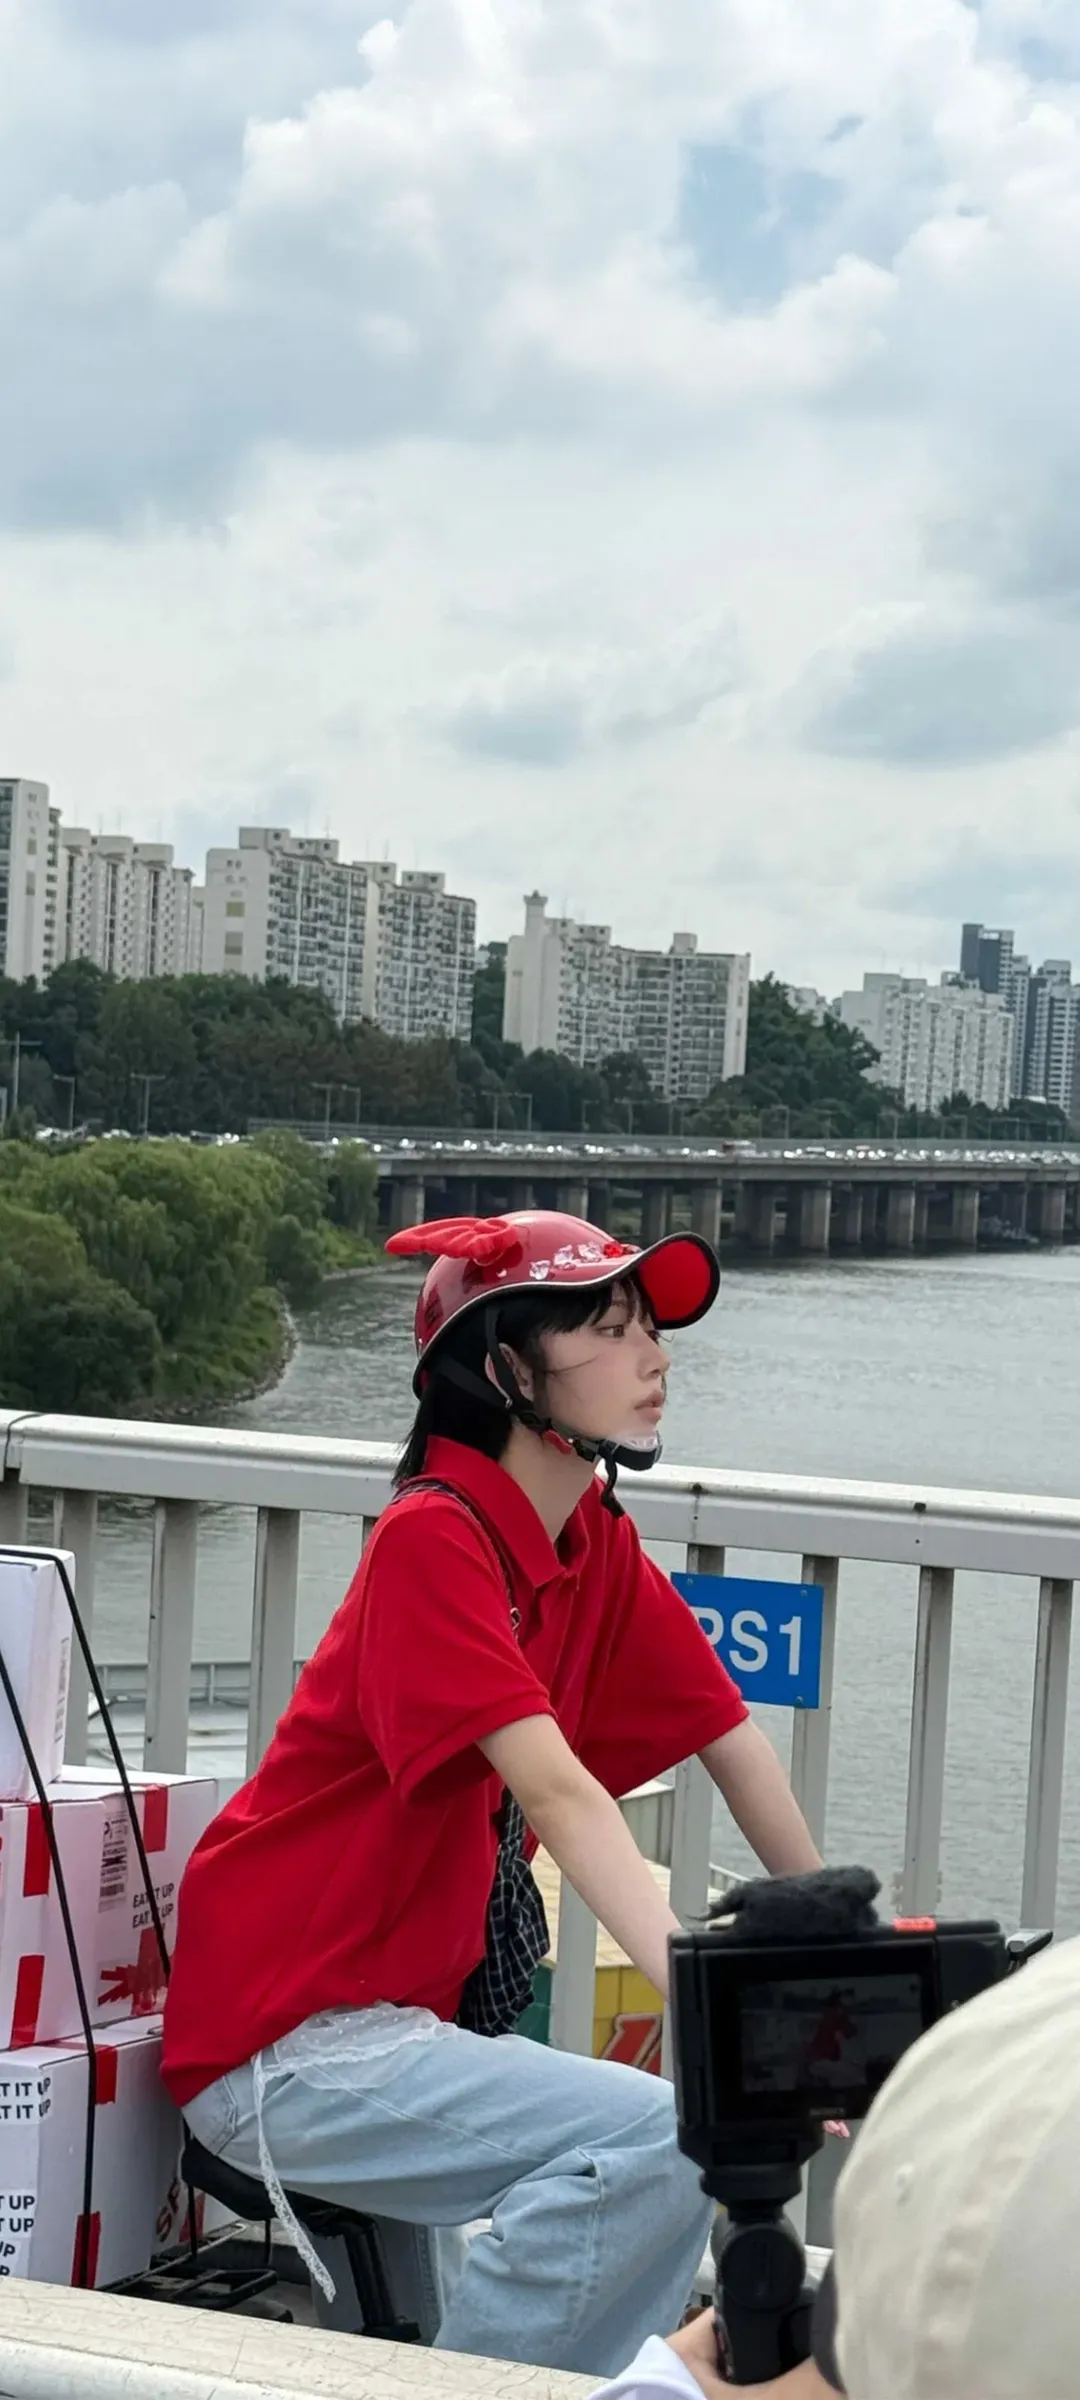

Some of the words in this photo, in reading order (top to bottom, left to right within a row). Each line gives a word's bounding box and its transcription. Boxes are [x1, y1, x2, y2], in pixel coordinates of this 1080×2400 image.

[689, 1606, 802, 1676] PS1
[162, 1883, 175, 1898] UP
[161, 1903, 174, 1918] UP
[0, 2082, 11, 2097] T
[15, 2082, 32, 2097] IT
[0, 2104, 12, 2119] T
[16, 2104, 34, 2119] IT
[9, 2195, 36, 2210] UP
[9, 2218, 35, 2233] UP
